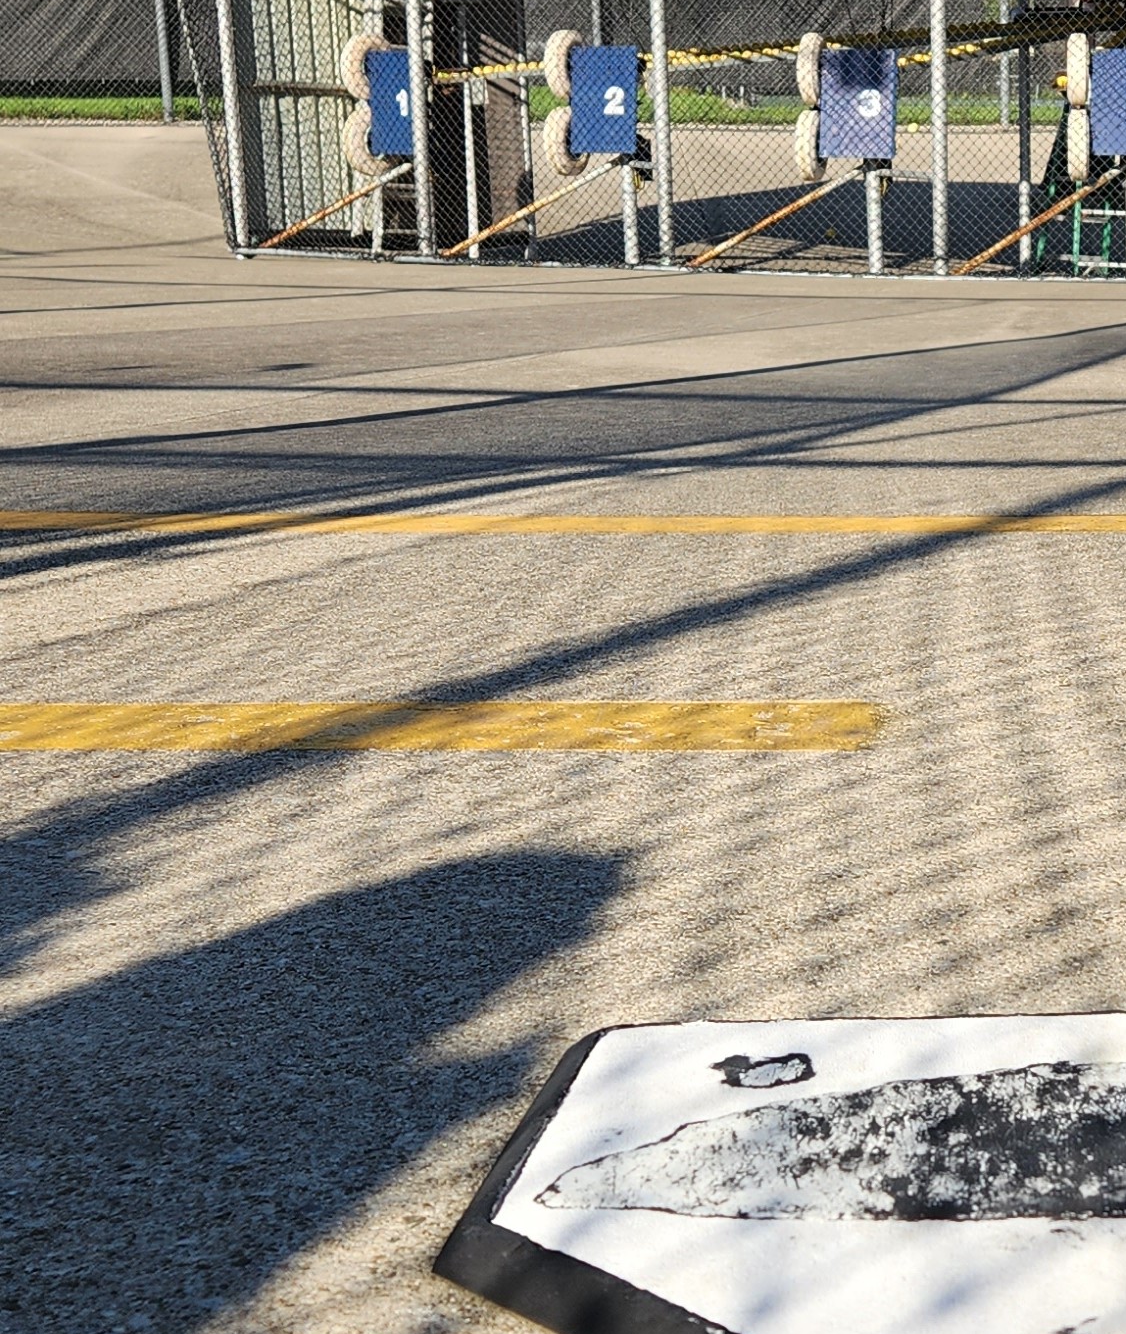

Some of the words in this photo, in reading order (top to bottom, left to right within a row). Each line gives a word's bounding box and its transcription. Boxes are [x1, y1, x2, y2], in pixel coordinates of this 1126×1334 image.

[396, 89, 409, 116] 1
[604, 86, 624, 115] 2
[859, 89, 880, 116] 3
